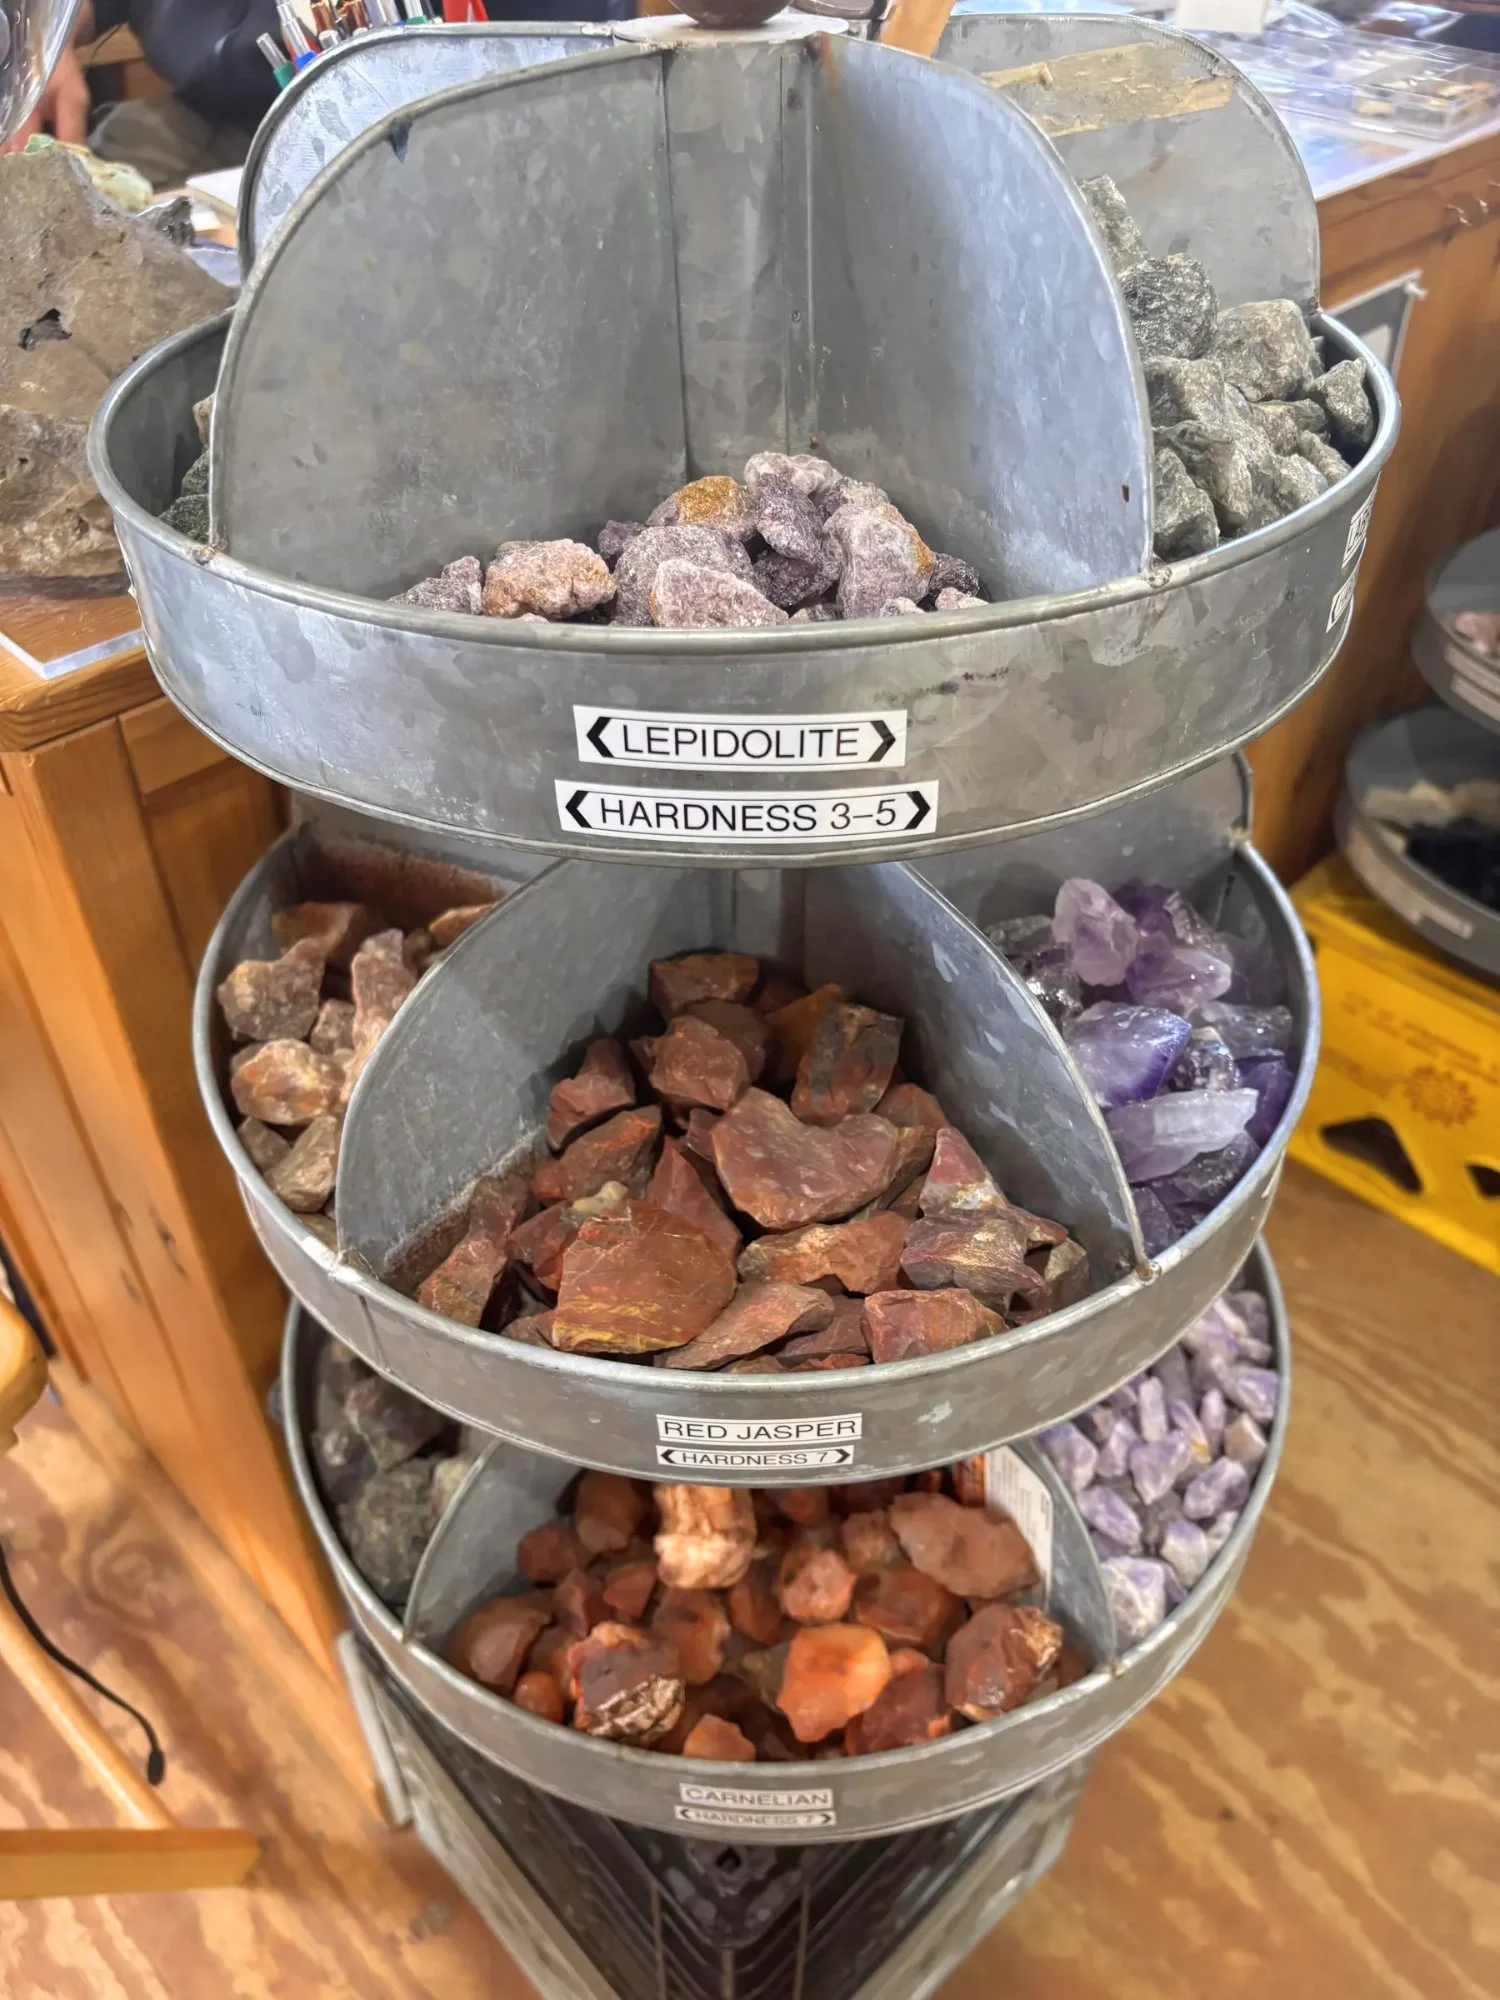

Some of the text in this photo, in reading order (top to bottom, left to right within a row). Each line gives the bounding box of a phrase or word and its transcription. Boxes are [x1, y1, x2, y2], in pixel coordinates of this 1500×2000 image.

[622, 724, 860, 760] LEPIDOLITE
[600, 797, 817, 832] HARDNESS
[664, 1420, 856, 1440] RED JASPER
[682, 1452, 828, 1466] HARDNESS 7
[685, 1788, 829, 1806] CARNELIAN
